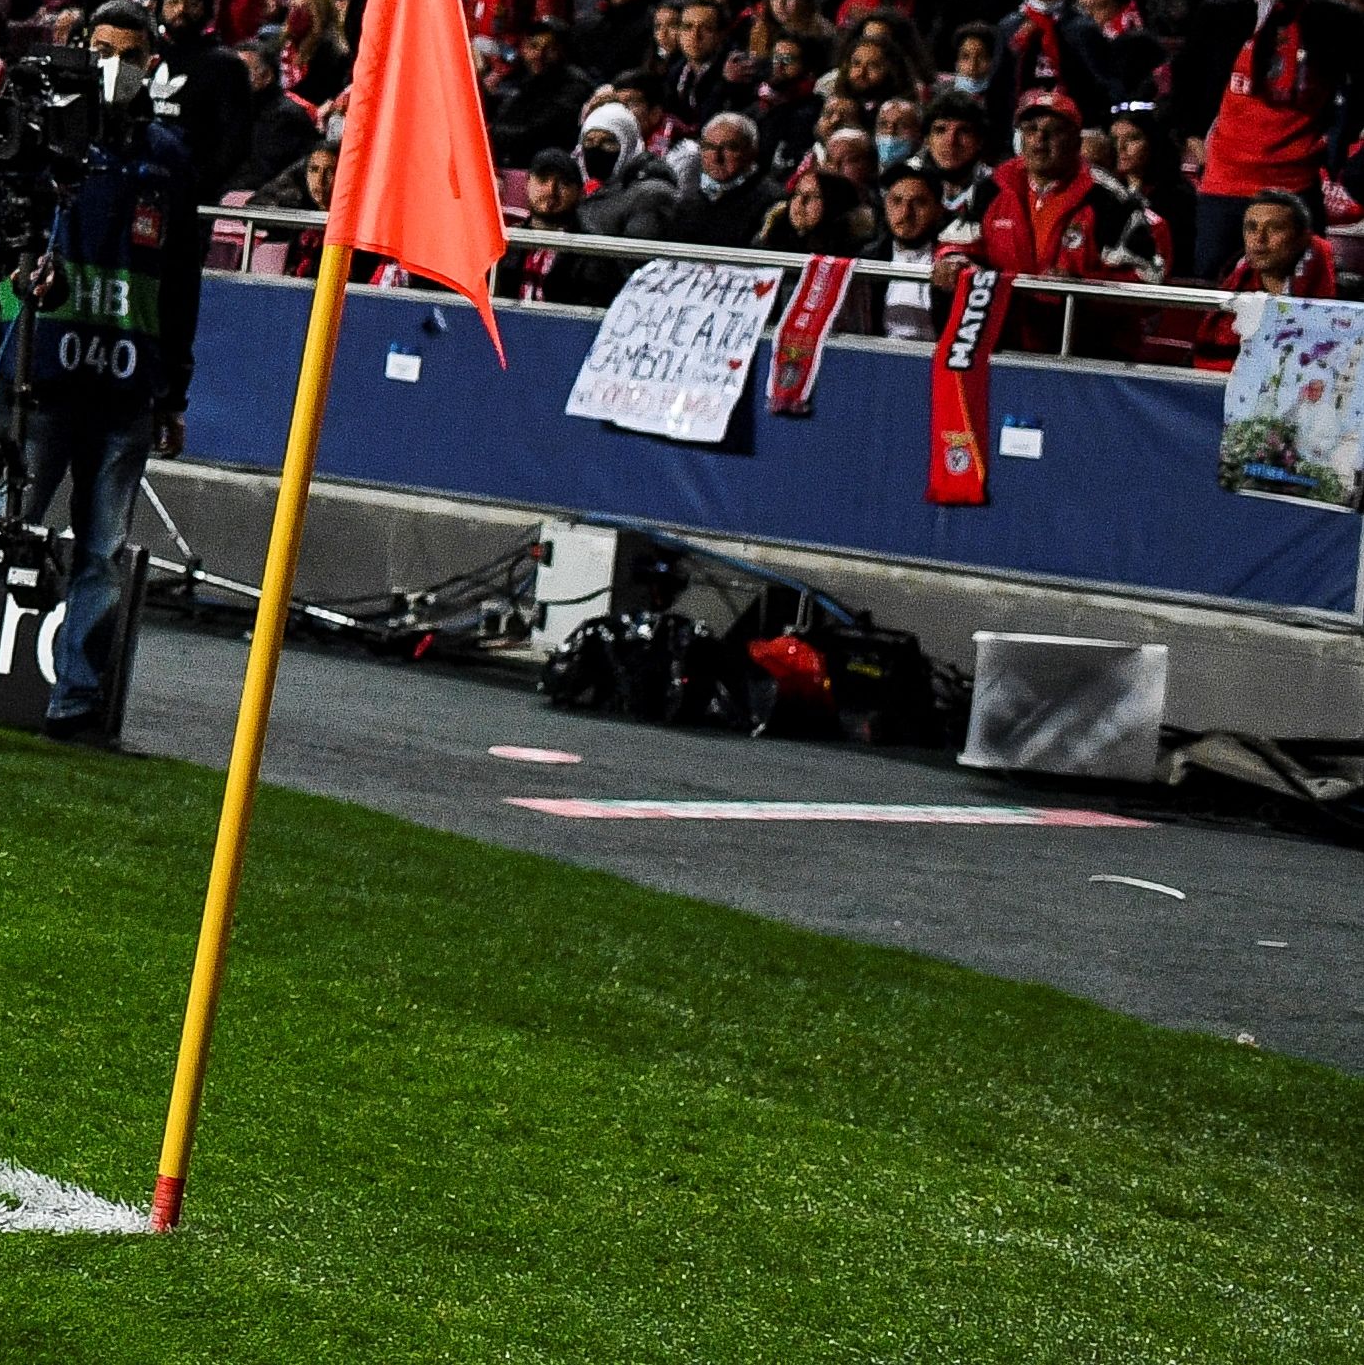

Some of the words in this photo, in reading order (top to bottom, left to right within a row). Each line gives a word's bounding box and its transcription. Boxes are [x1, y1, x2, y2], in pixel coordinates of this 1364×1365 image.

[75, 275, 131, 317] HB
[947, 270, 999, 369] MATOS
[58, 332, 138, 380] 040
